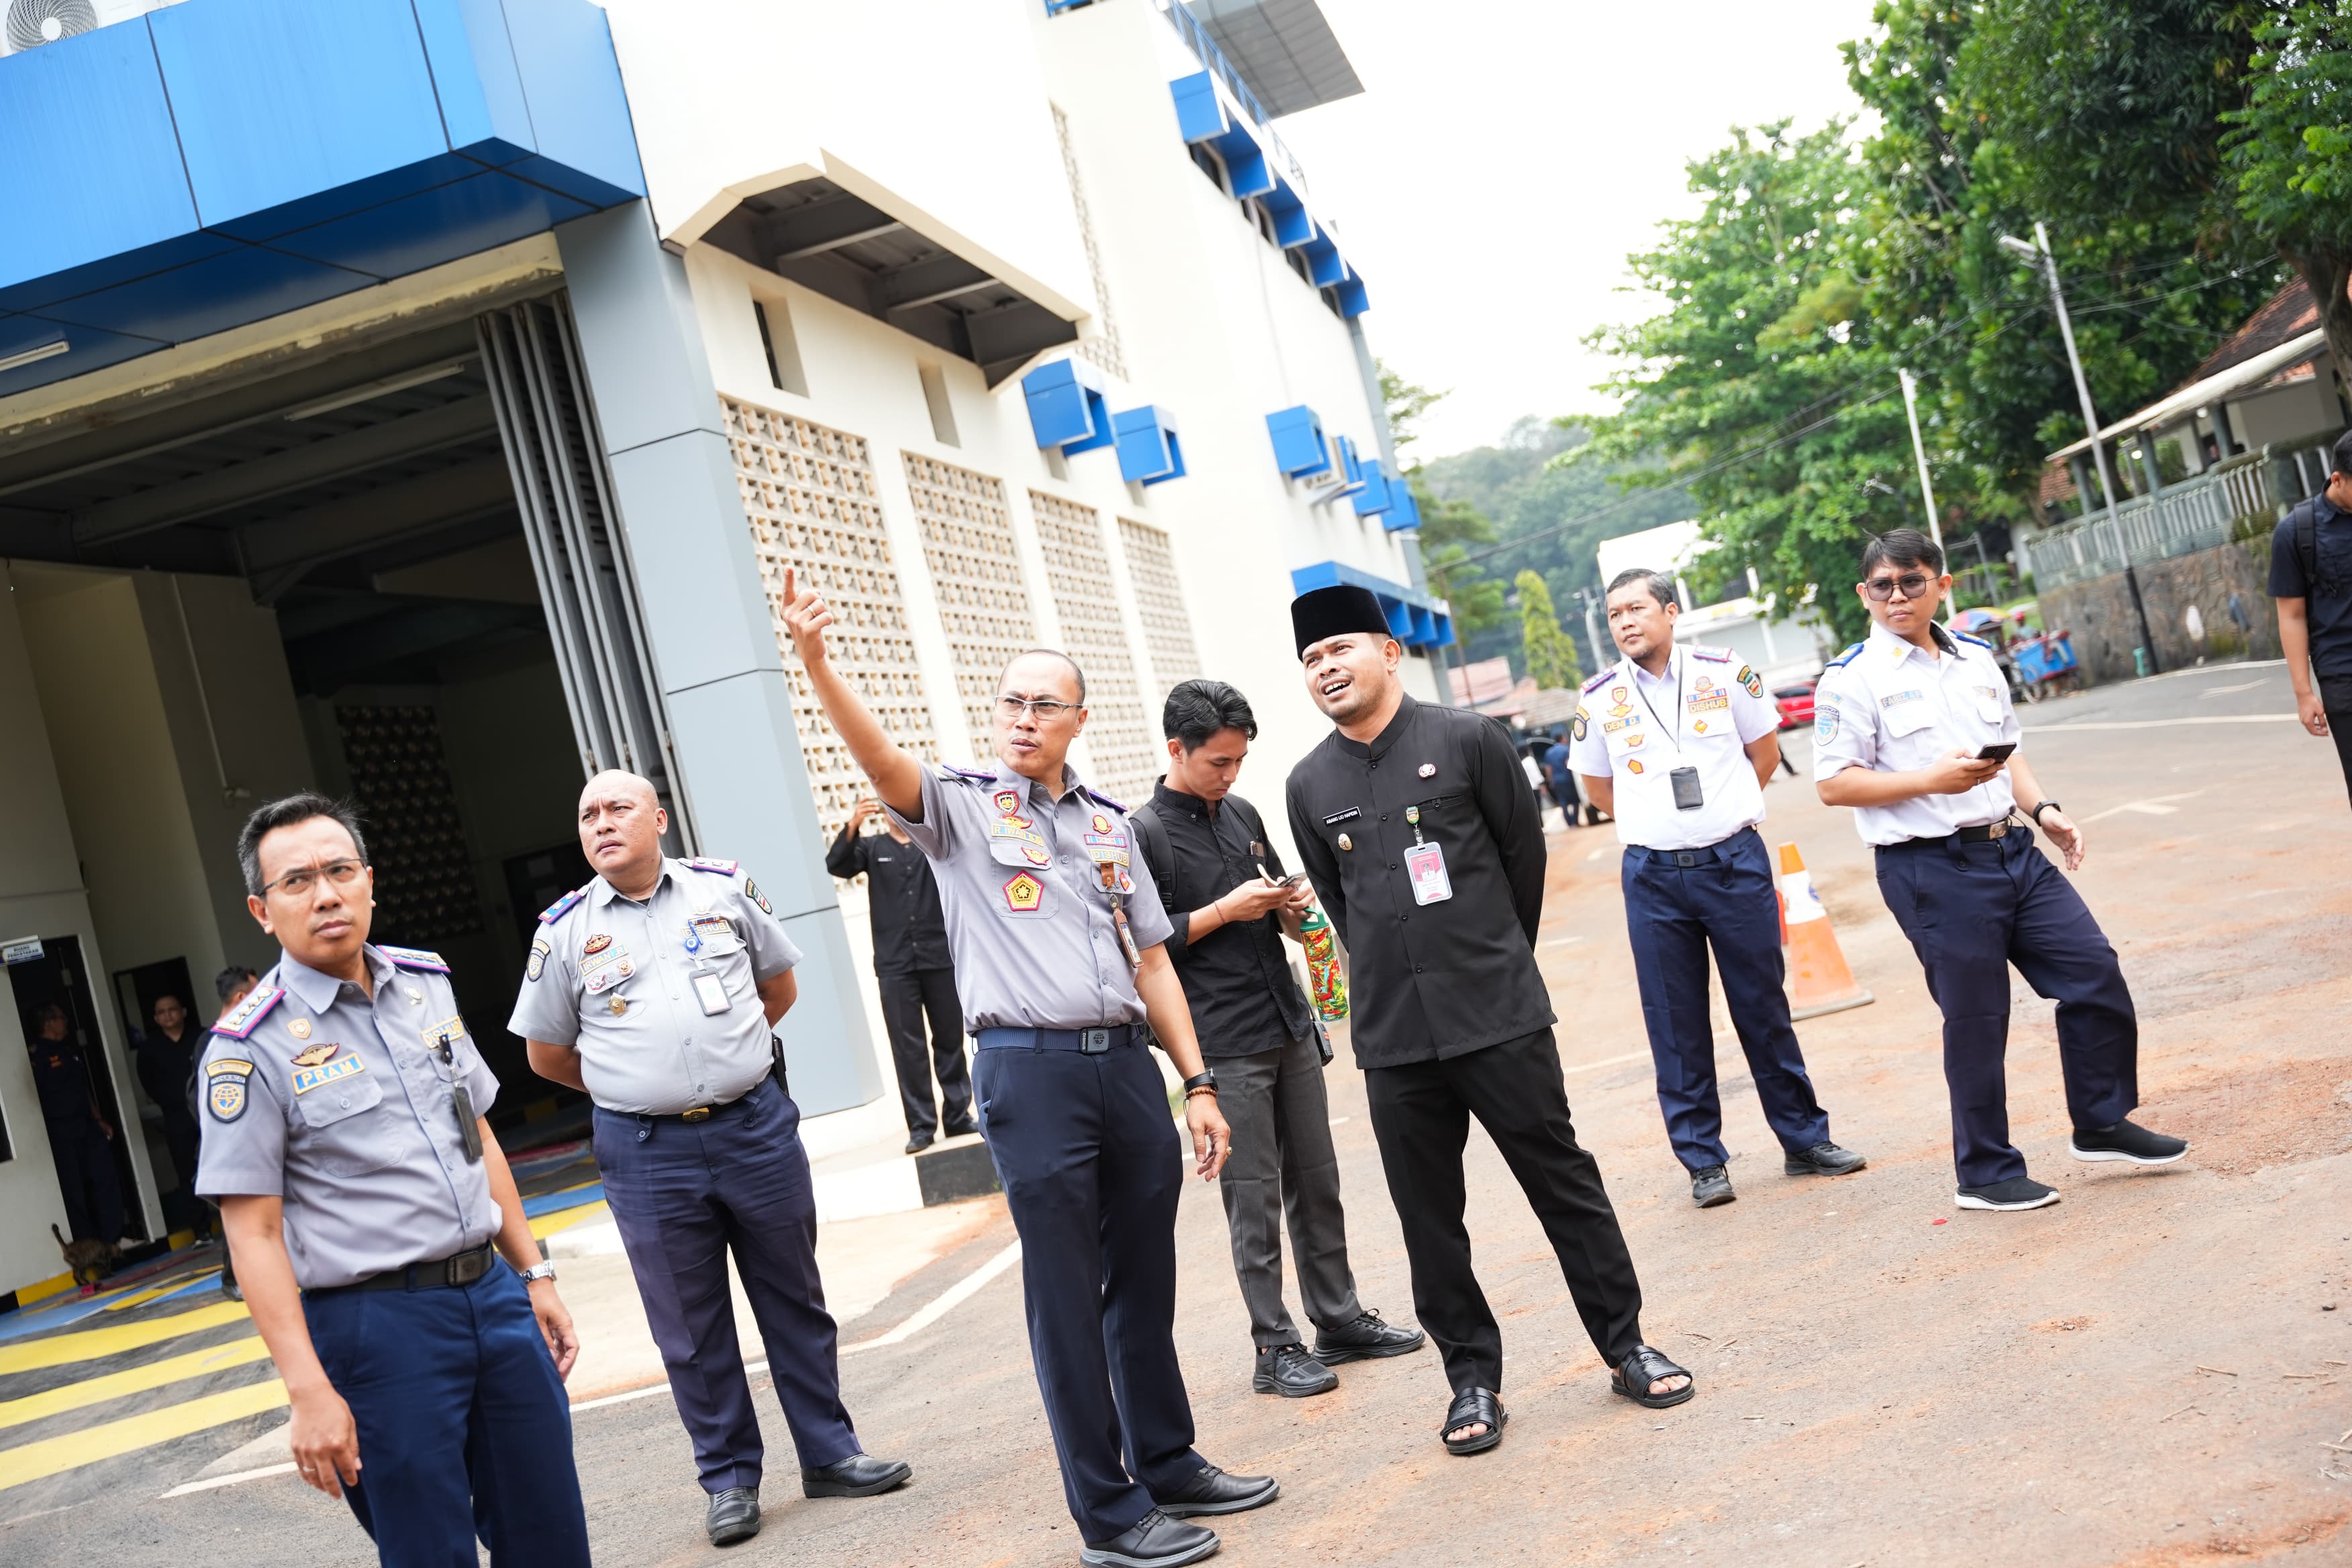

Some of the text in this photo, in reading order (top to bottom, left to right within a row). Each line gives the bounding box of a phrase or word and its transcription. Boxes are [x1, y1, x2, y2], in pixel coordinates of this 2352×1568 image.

[1689, 699, 1726, 712] DISHUB
[1605, 720, 1624, 732] DENI
[1093, 851, 1127, 863] DISHUB
[685, 922, 725, 936] DSHUB
[583, 952, 611, 973] IRWAN
[301, 1061, 355, 1087] PRAM
